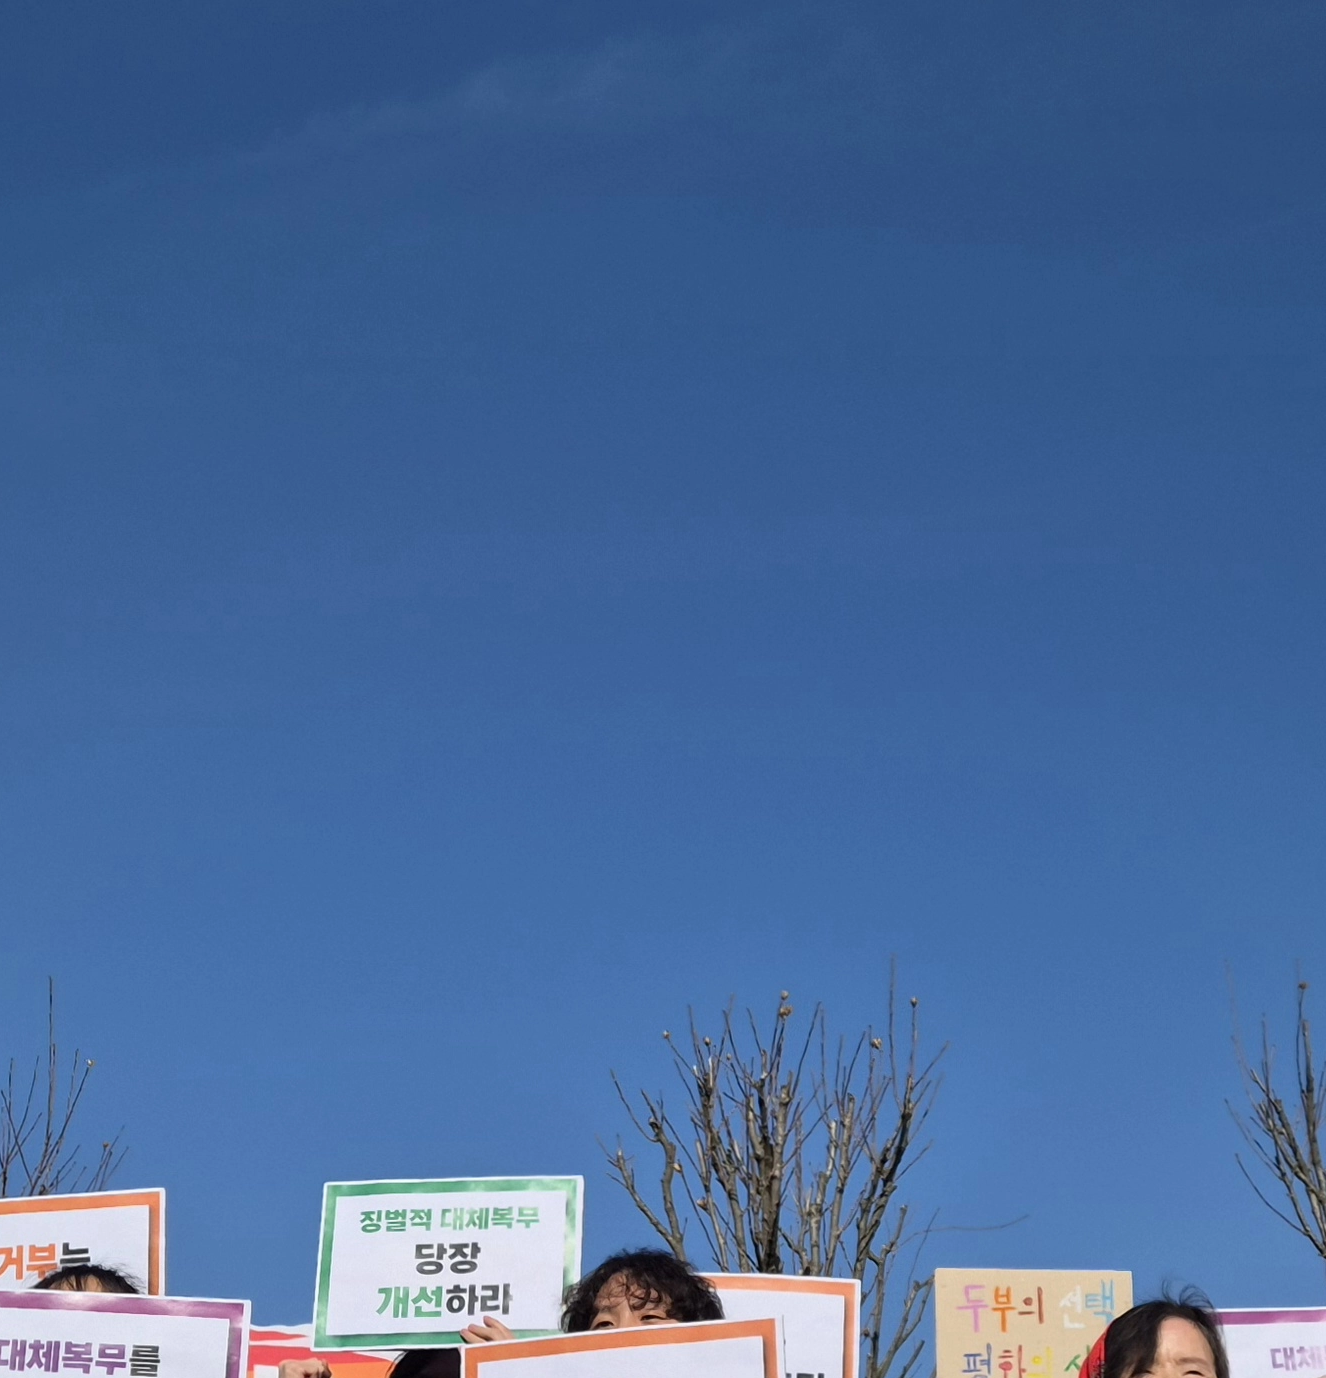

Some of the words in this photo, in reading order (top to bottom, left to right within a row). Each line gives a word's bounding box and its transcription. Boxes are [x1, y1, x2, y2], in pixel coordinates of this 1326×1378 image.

[358, 1207, 434, 1233] 징벌적
[440, 1205, 540, 1232] 대체복무
[413, 1242, 481, 1276] 당장
[377, 1283, 513, 1319] 개선하라
[957, 1285, 1044, 1333] 두부의
[1060, 1279, 1115, 1329] 선택
